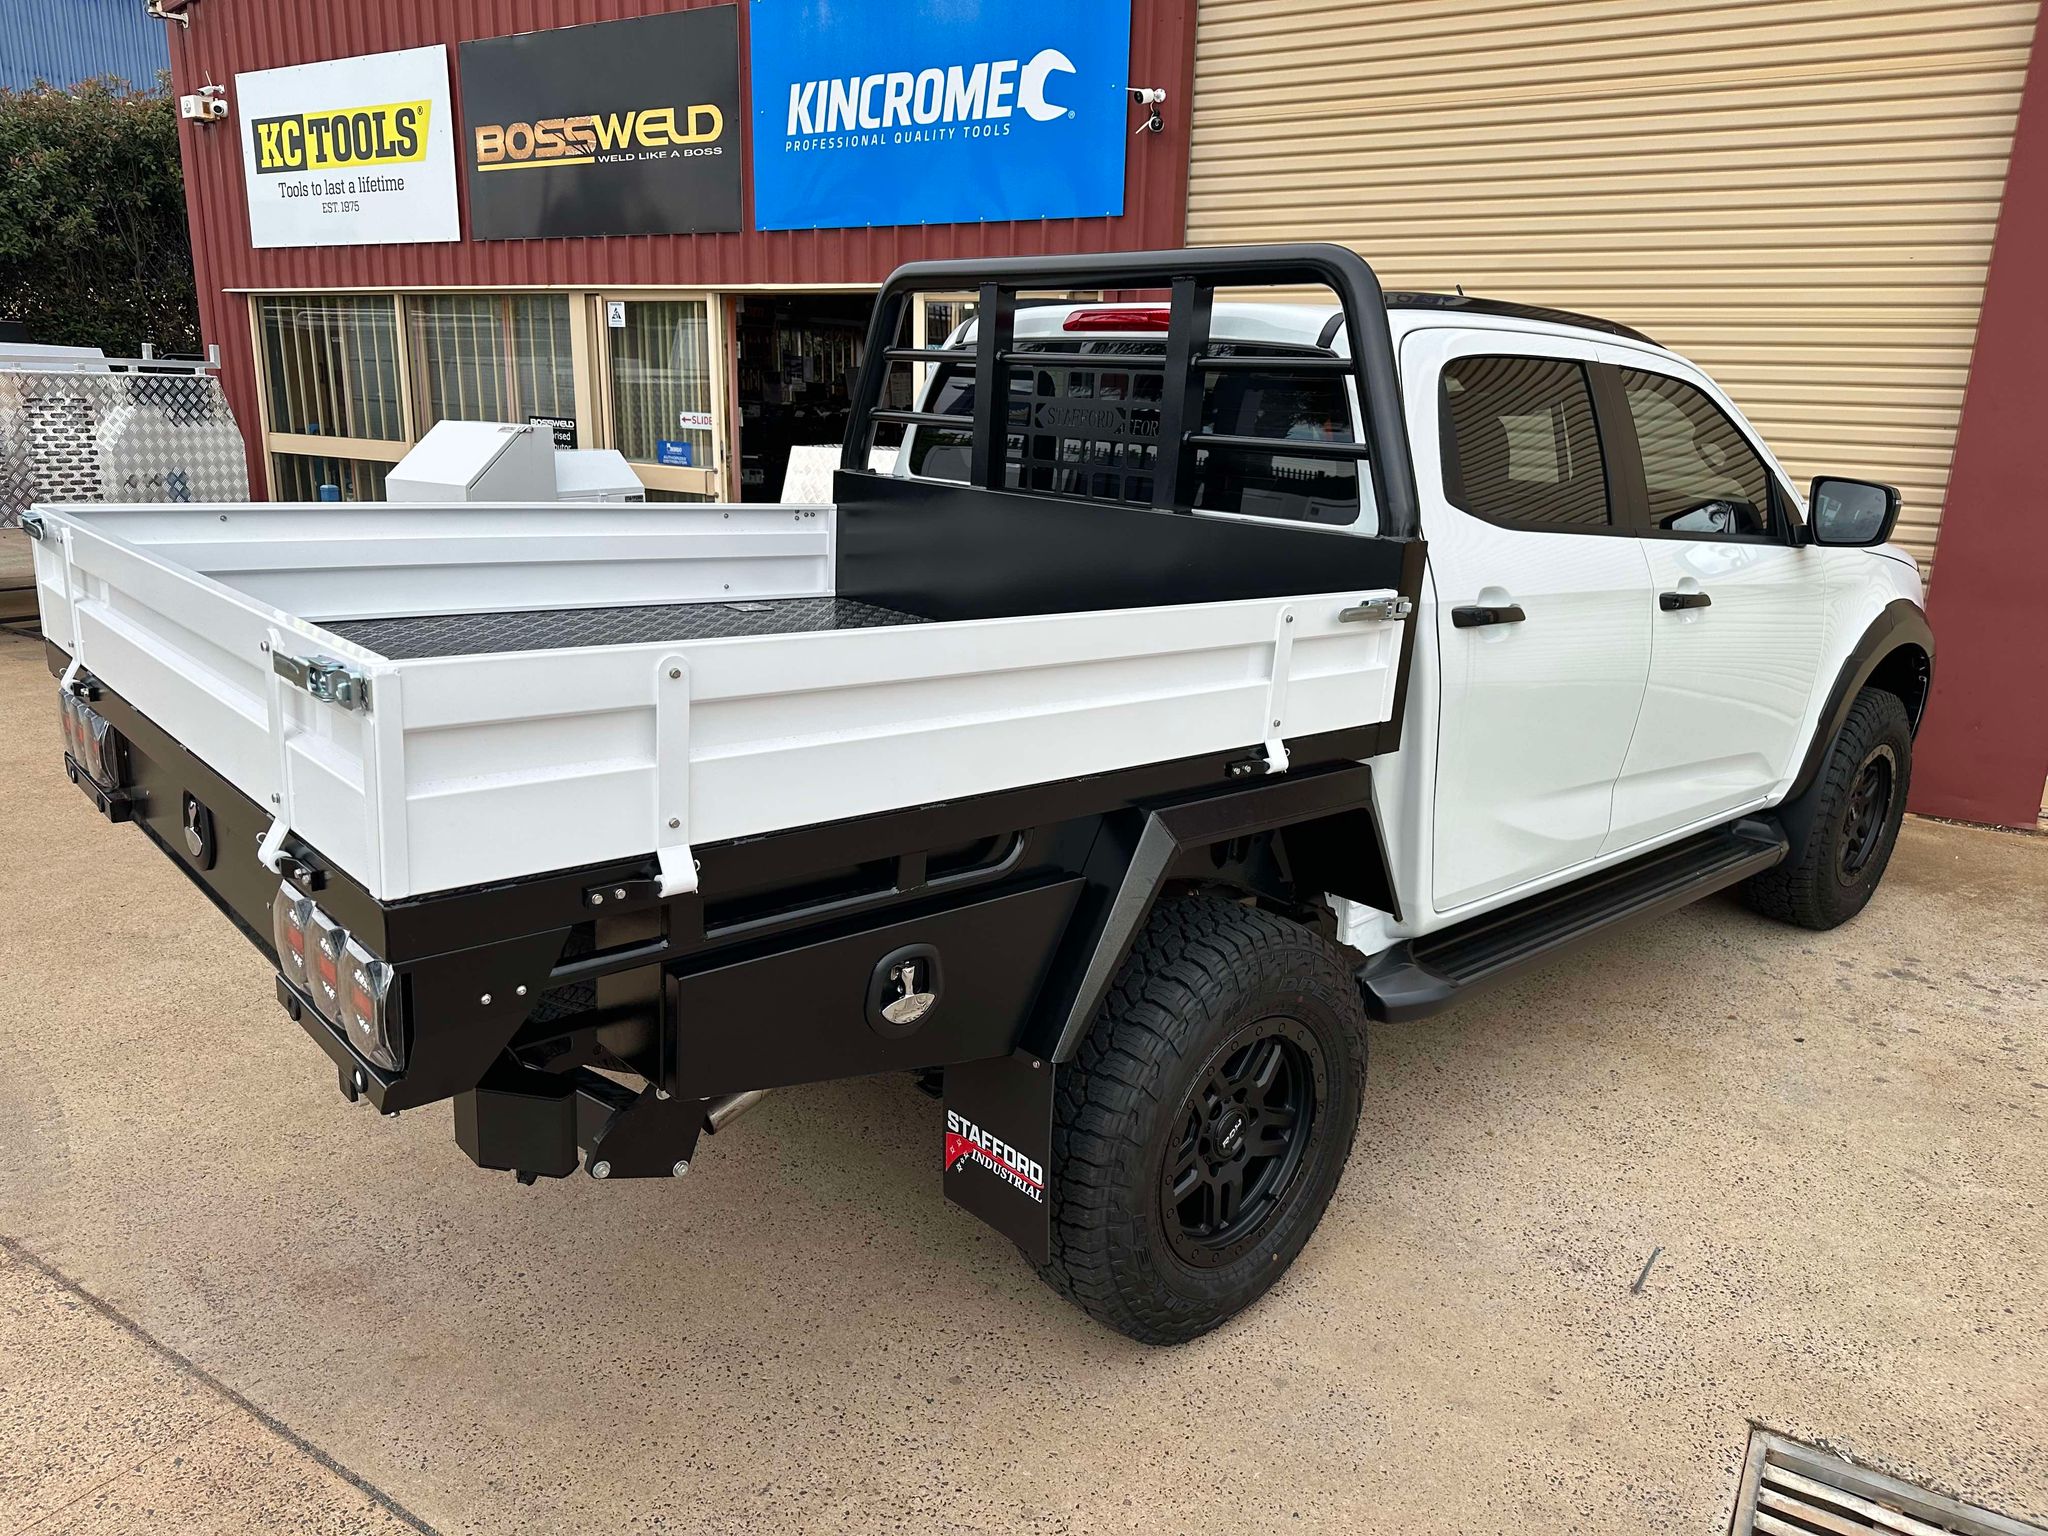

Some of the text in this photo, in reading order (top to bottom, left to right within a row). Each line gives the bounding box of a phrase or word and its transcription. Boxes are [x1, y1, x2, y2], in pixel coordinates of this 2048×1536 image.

[787, 60, 1018, 136] KINCROME
[257, 108, 418, 168] KC TOOLS
[475, 104, 723, 163] BOSSWELD
[786, 123, 1010, 152] PROFESSIONAL QUALITY TOOLS
[598, 147, 723, 163] WELD LIKE A BOSS
[278, 175, 405, 198] Tools to last a lifetime
[322, 201, 360, 214] EST. 1975
[530, 419, 575, 428] BOSSWELD
[691, 416, 713, 425] SLIDE
[553, 431, 571, 441] rised
[947, 1109, 1043, 1186] STAFFORD
[970, 1148, 1043, 1203] INDUSTRIAL
